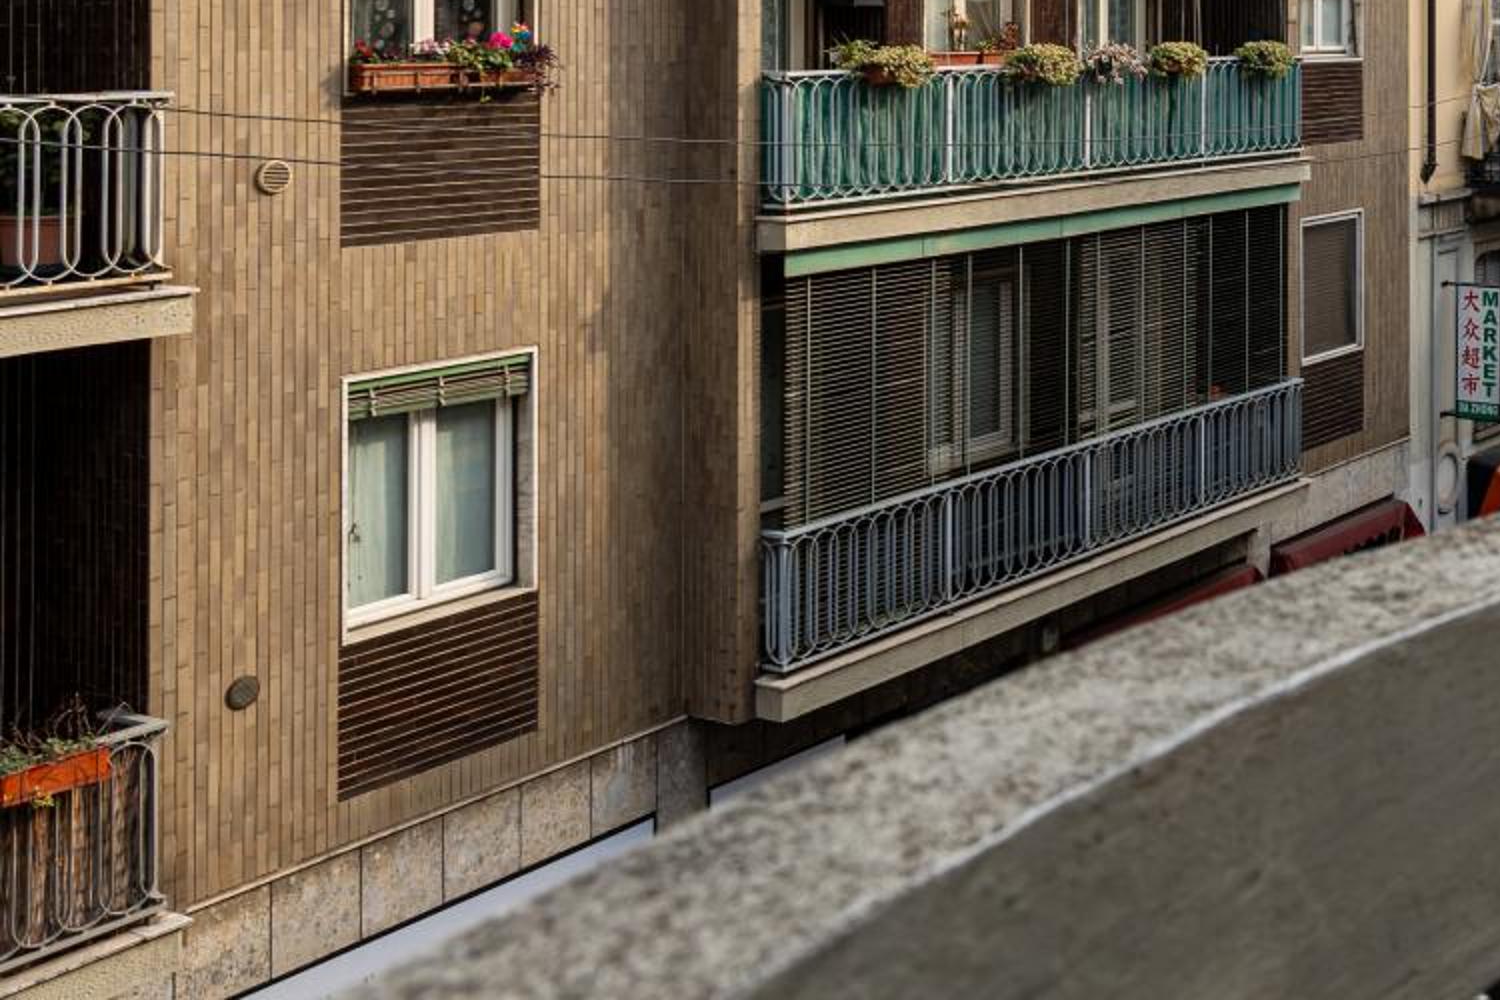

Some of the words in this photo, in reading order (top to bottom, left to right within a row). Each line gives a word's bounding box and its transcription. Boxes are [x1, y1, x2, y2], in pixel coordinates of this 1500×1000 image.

[1461, 289, 1481, 395] 大众超市
[1481, 291, 1499, 398] MARKET
